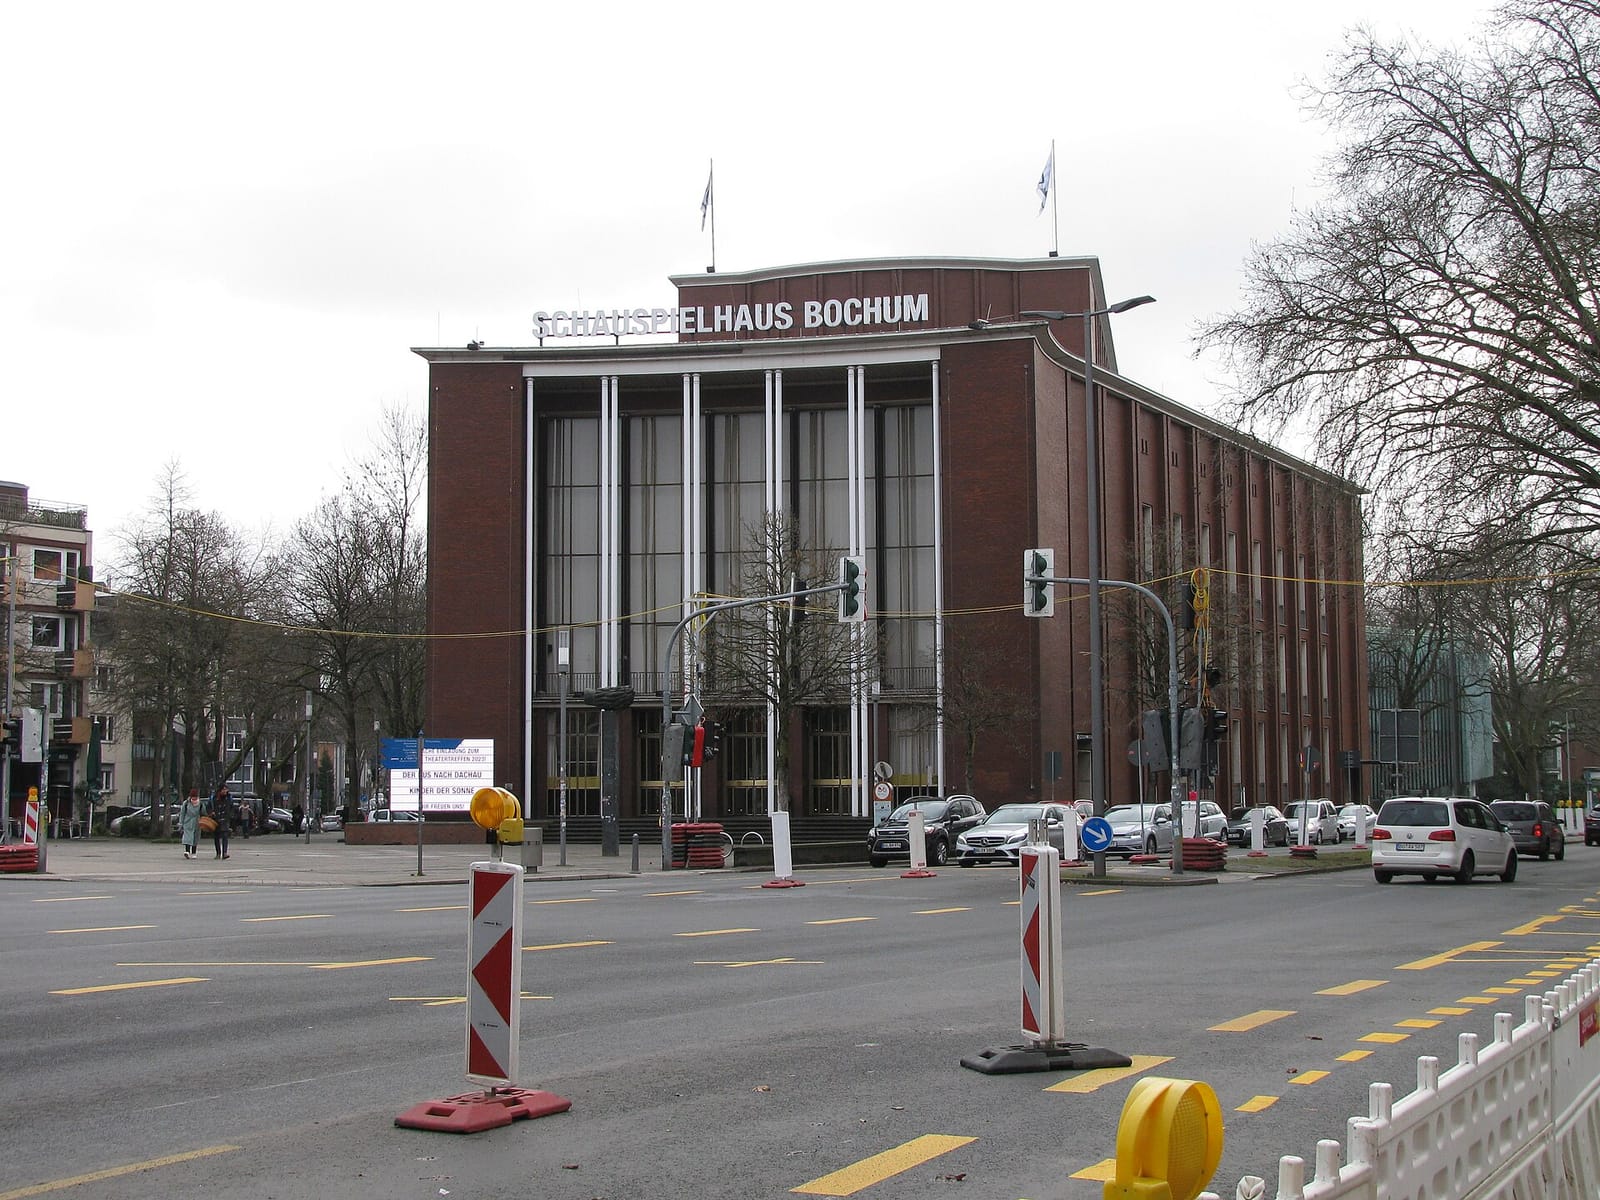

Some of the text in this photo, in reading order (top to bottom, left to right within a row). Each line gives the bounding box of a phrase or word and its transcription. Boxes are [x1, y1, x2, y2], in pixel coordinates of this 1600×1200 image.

[532, 293, 929, 338] SCHAUSPIELHAUS BOCHUM
[402, 771, 416, 779] DER
[433, 771, 453, 779] NACH
[454, 771, 482, 779] DACHAU
